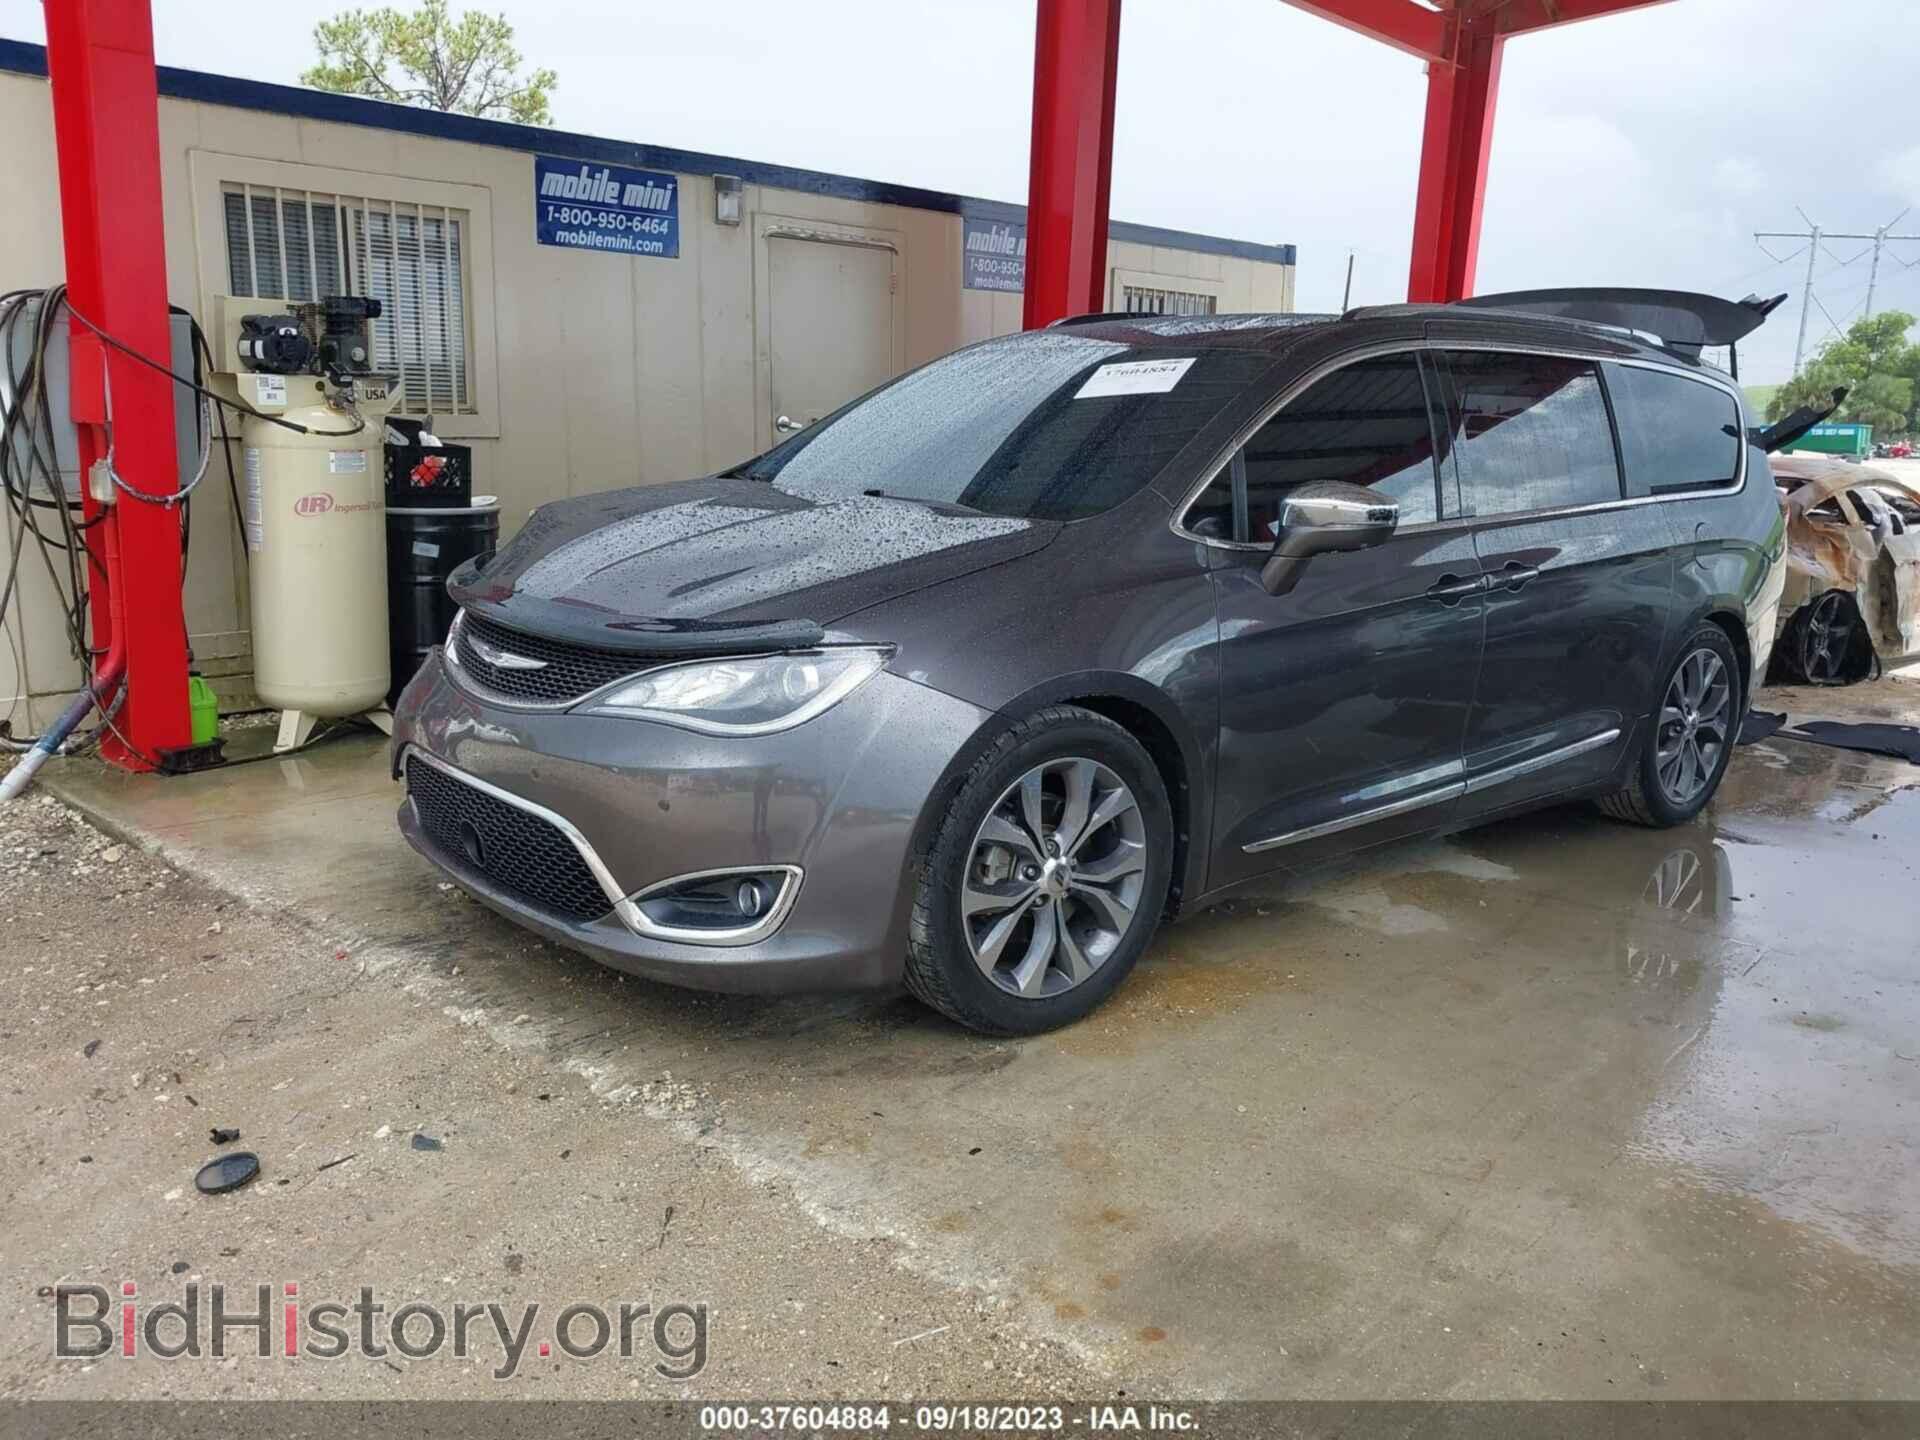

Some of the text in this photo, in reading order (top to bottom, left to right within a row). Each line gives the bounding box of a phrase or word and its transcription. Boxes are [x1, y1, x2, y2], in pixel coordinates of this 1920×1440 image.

[540, 165, 673, 211] mobile mini
[547, 206, 669, 235] 1-800-950-6464
[555, 230, 664, 253] mobilemini.com
[966, 225, 1016, 255] mobile
[365, 390, 387, 400] USA
